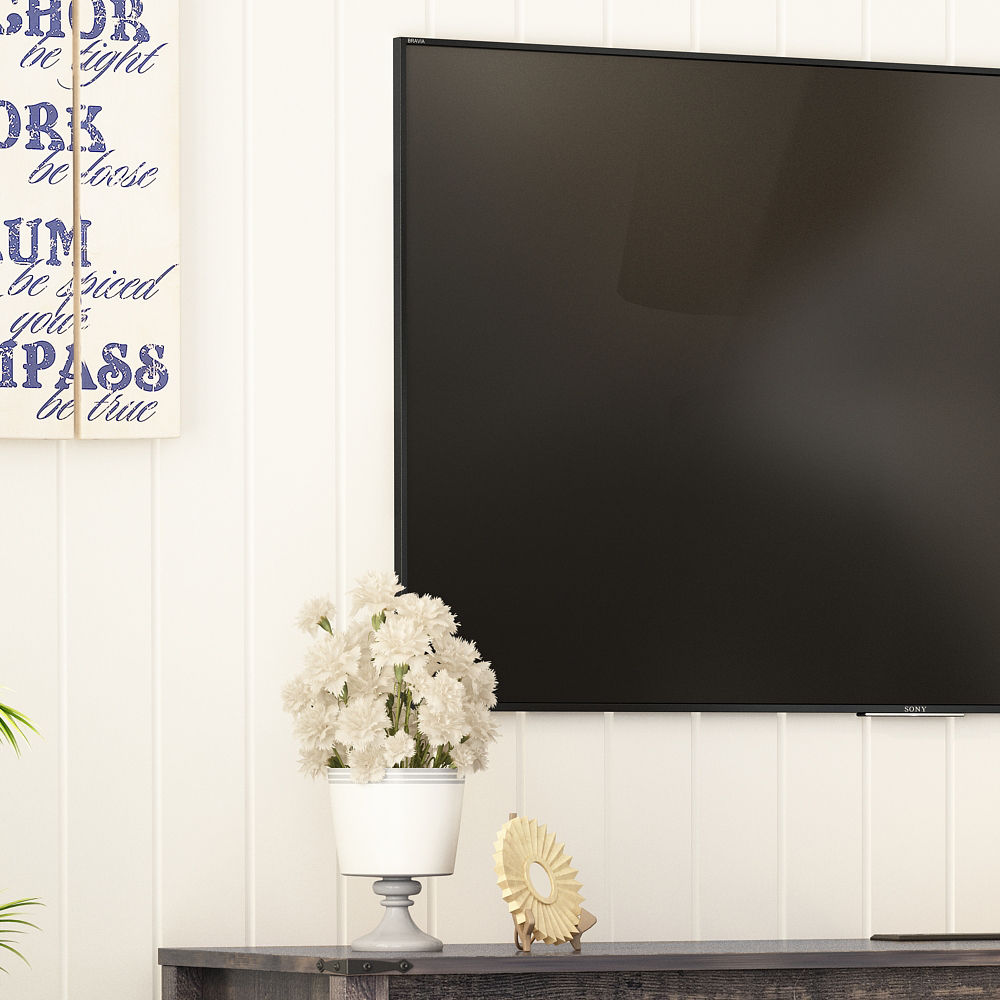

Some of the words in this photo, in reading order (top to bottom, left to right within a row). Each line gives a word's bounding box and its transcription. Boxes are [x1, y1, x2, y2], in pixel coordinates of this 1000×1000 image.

[20, 34, 62, 69] be
[28, 150, 70, 185] be
[0, 217, 92, 267] UM
[8, 258, 50, 297] be
[36, 388, 75, 420] be
[88, 392, 159, 422] true
[904, 705, 927, 713] SONY
